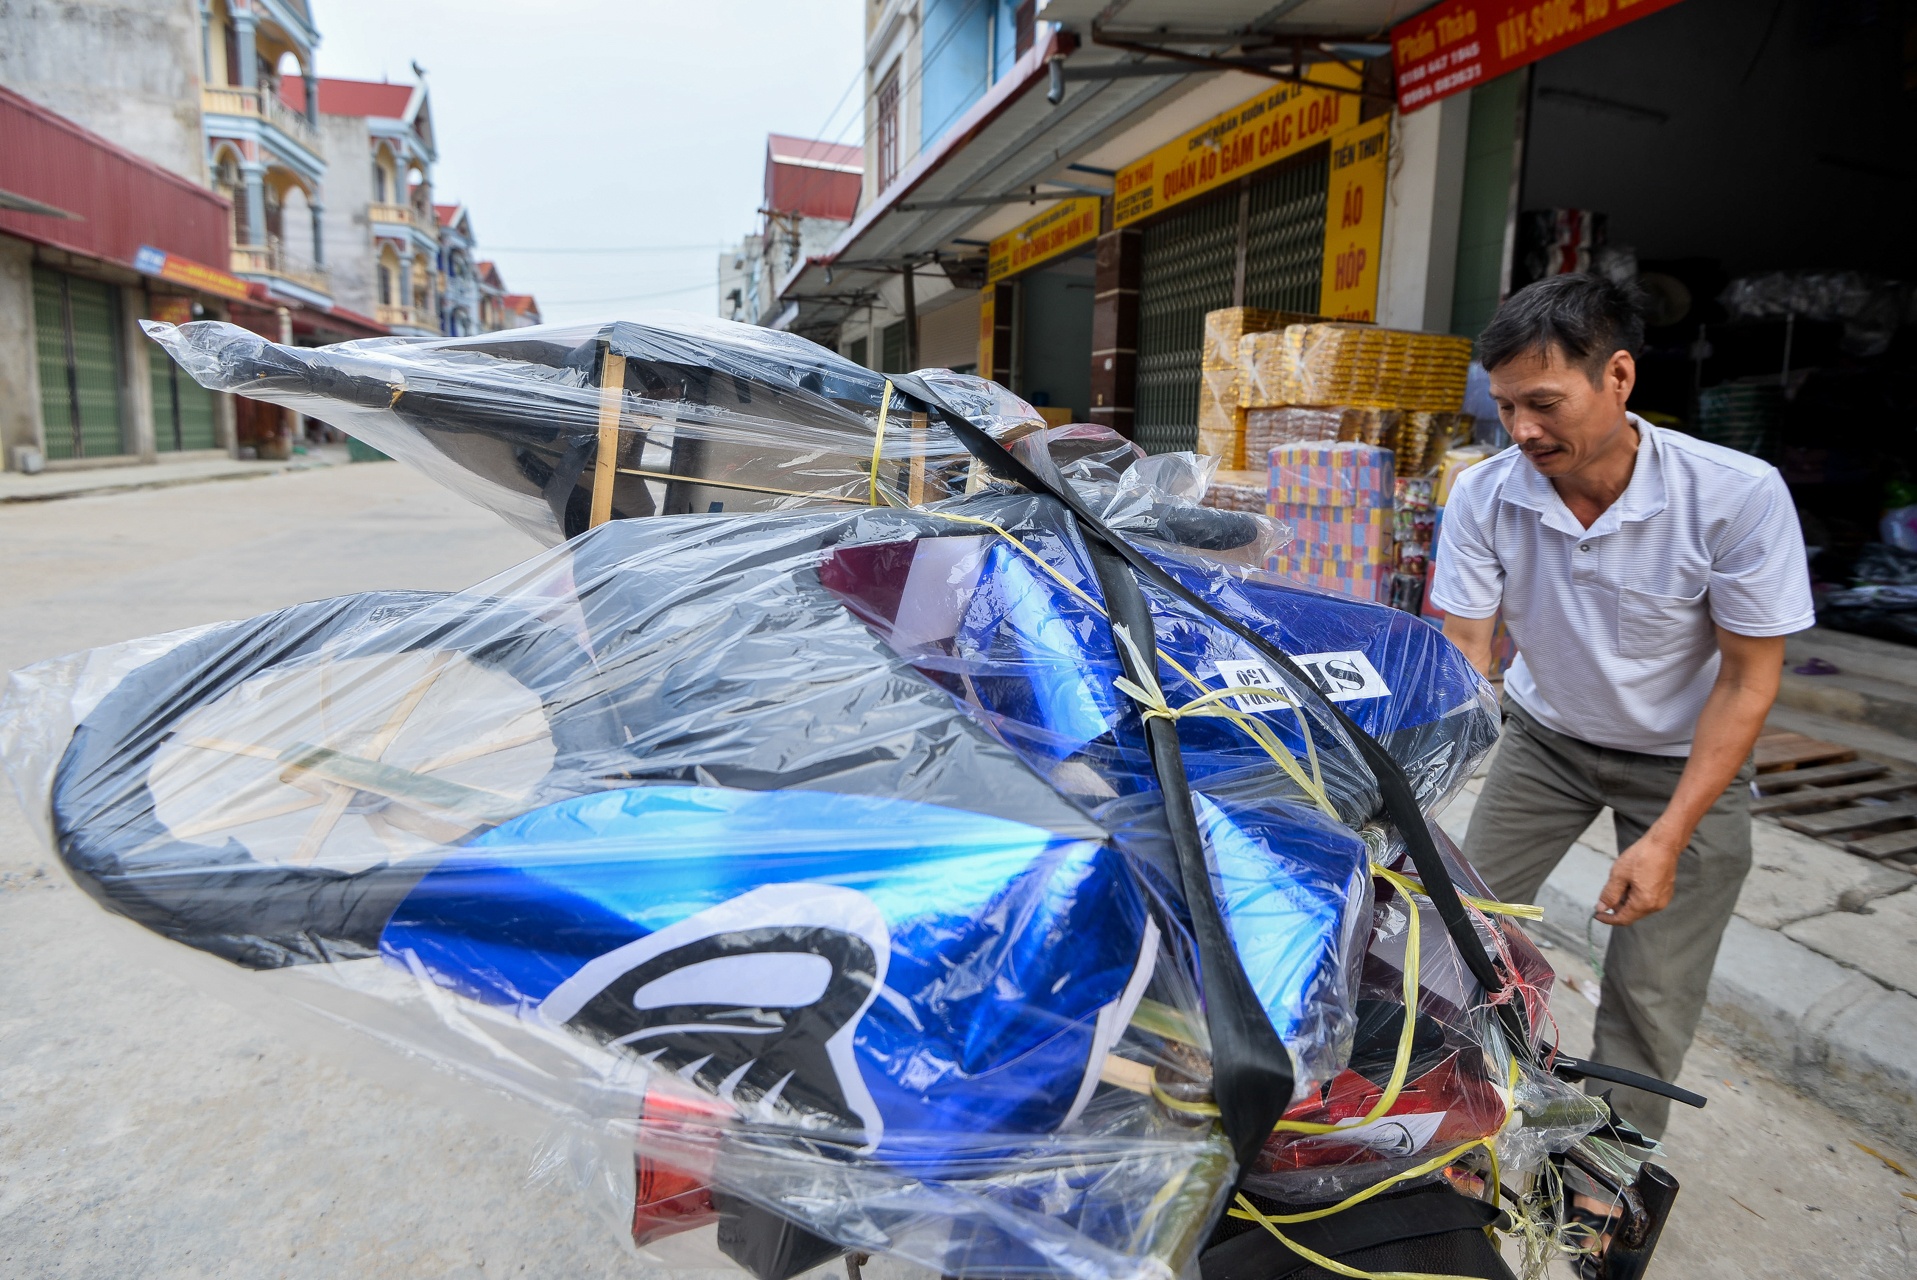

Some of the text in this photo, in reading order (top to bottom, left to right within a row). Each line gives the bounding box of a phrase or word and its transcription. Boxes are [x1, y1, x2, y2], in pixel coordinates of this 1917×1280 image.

[1199, 148, 1217, 185] ÁO
[1259, 113, 1292, 157] CÁC
[1298, 91, 1340, 139] LOẠI
[1342, 181, 1363, 229] ÁO
[1236, 667, 1271, 687] 150
